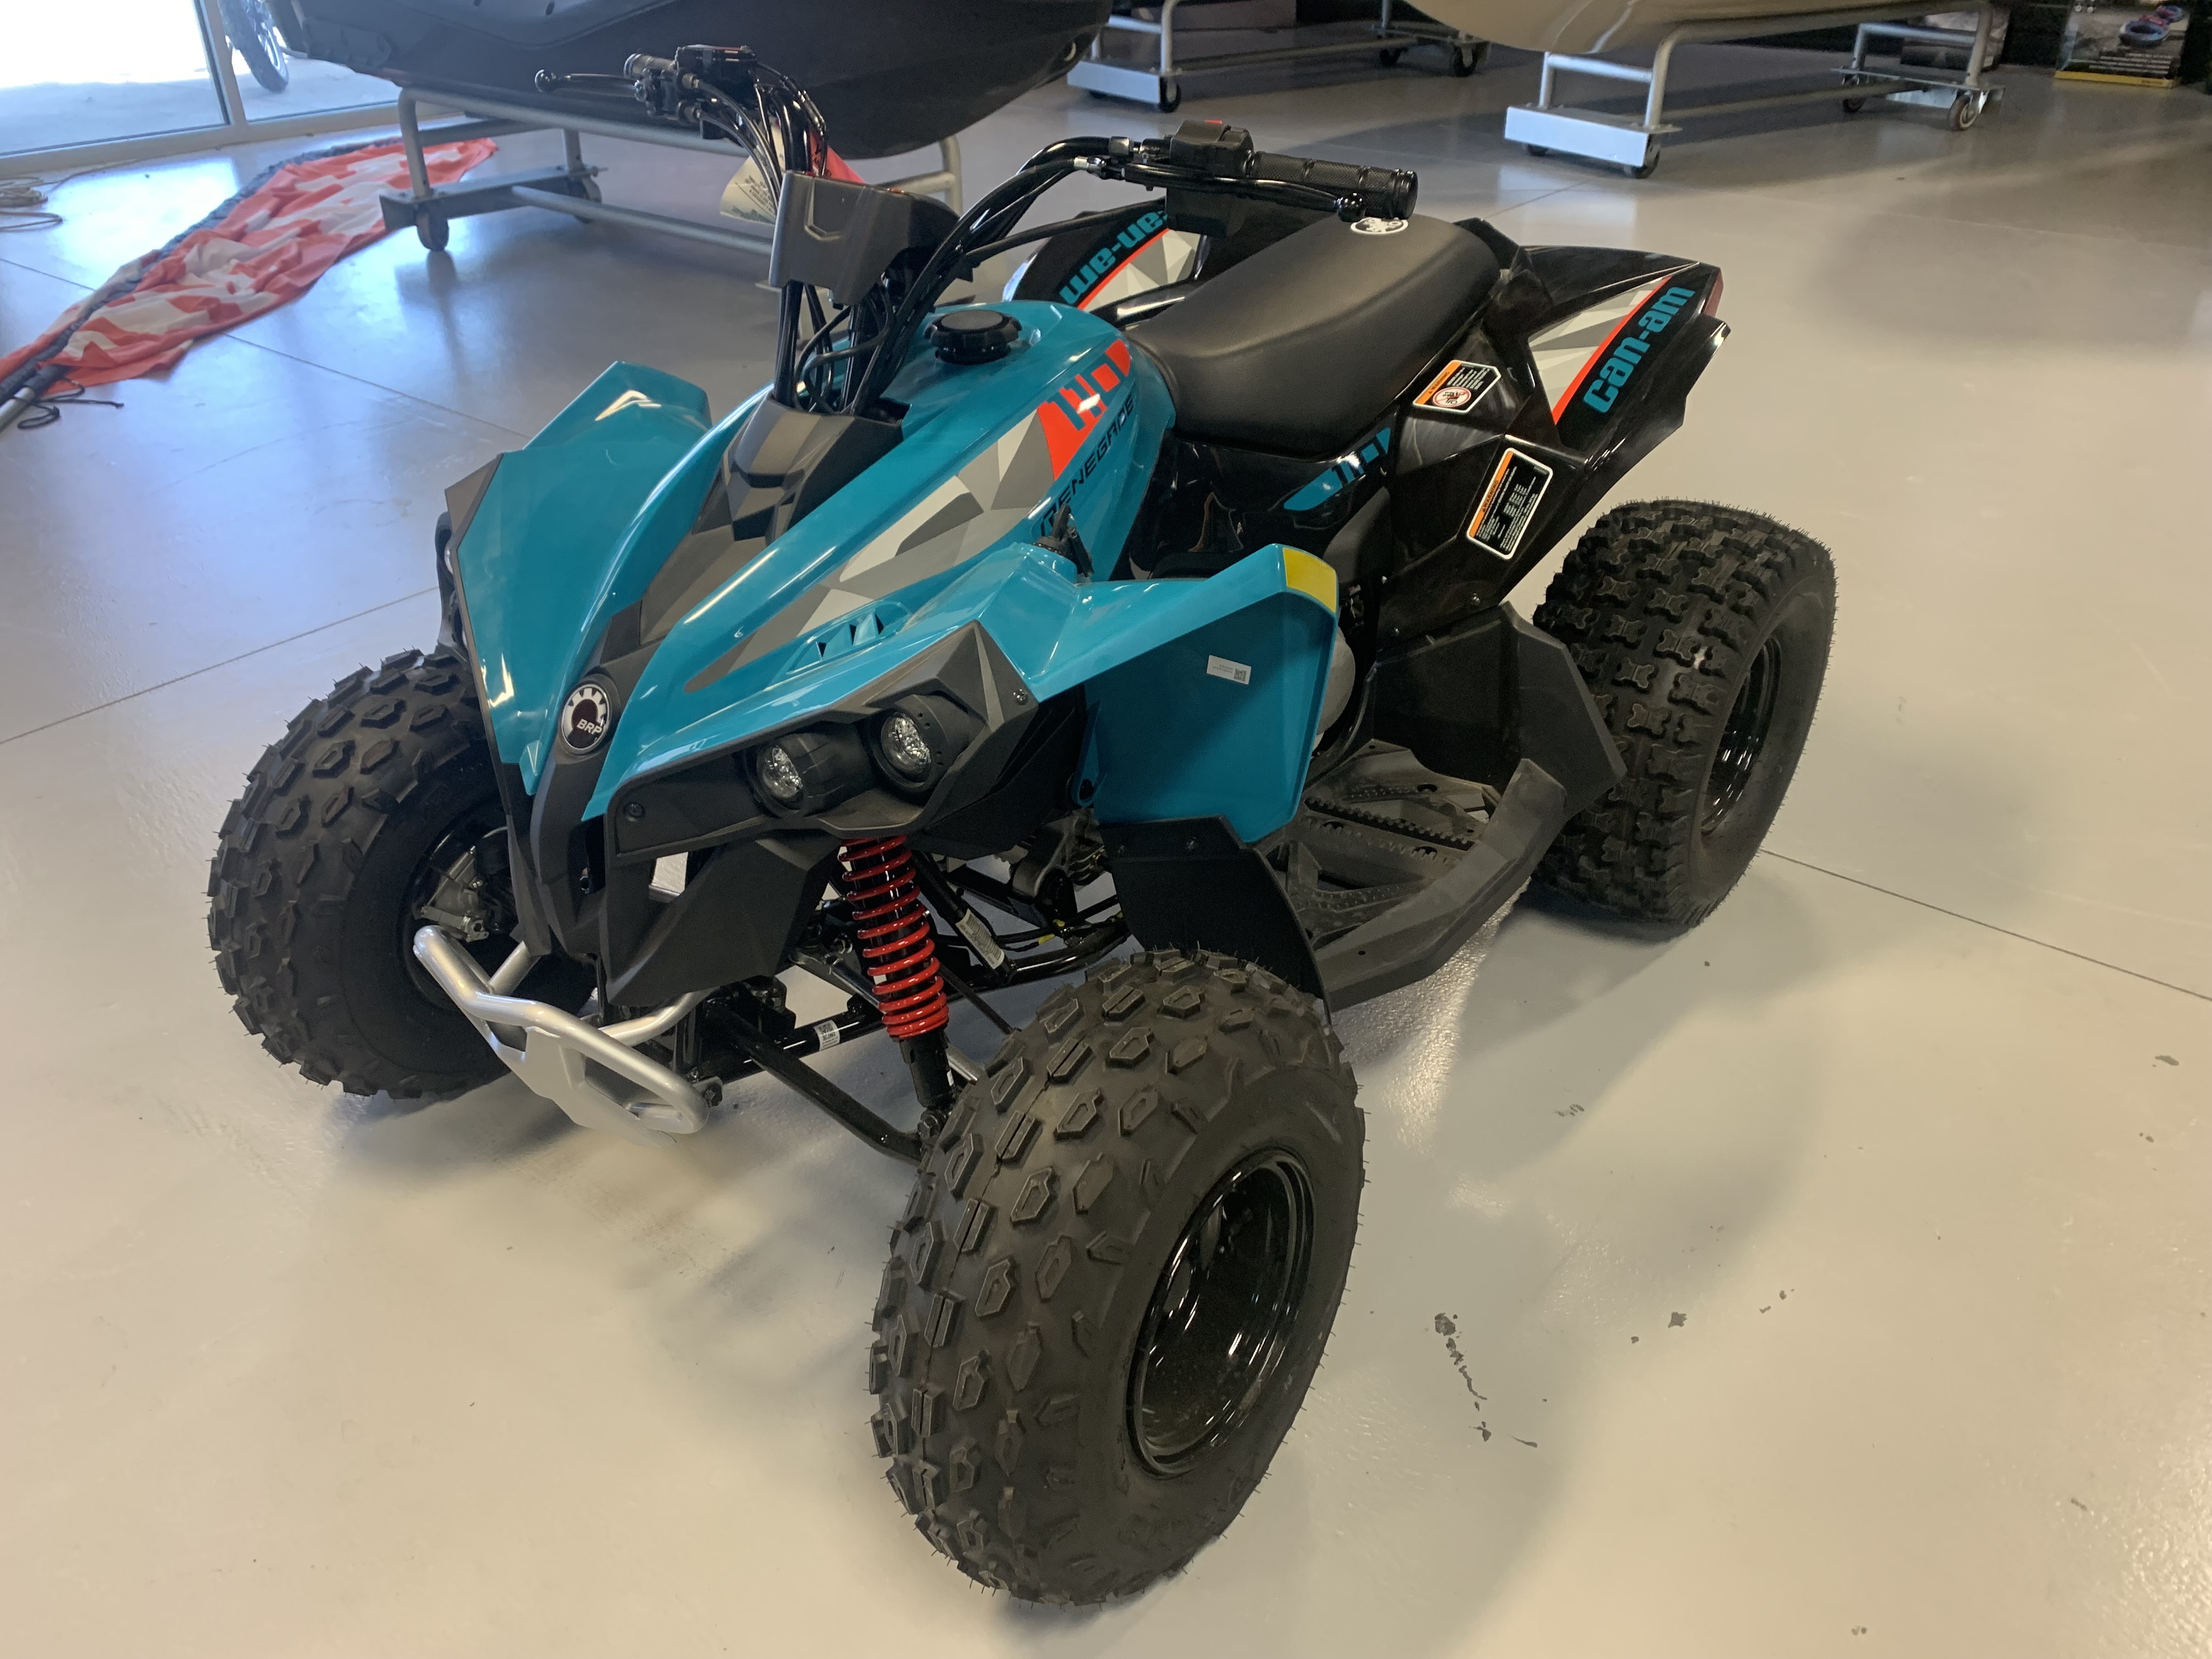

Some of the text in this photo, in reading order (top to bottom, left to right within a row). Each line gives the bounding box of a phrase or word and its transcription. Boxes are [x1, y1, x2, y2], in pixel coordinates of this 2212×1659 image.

[1059, 211, 1167, 305] an-am
[1583, 287, 1696, 413] can-am
[577, 718, 602, 735] BRP
